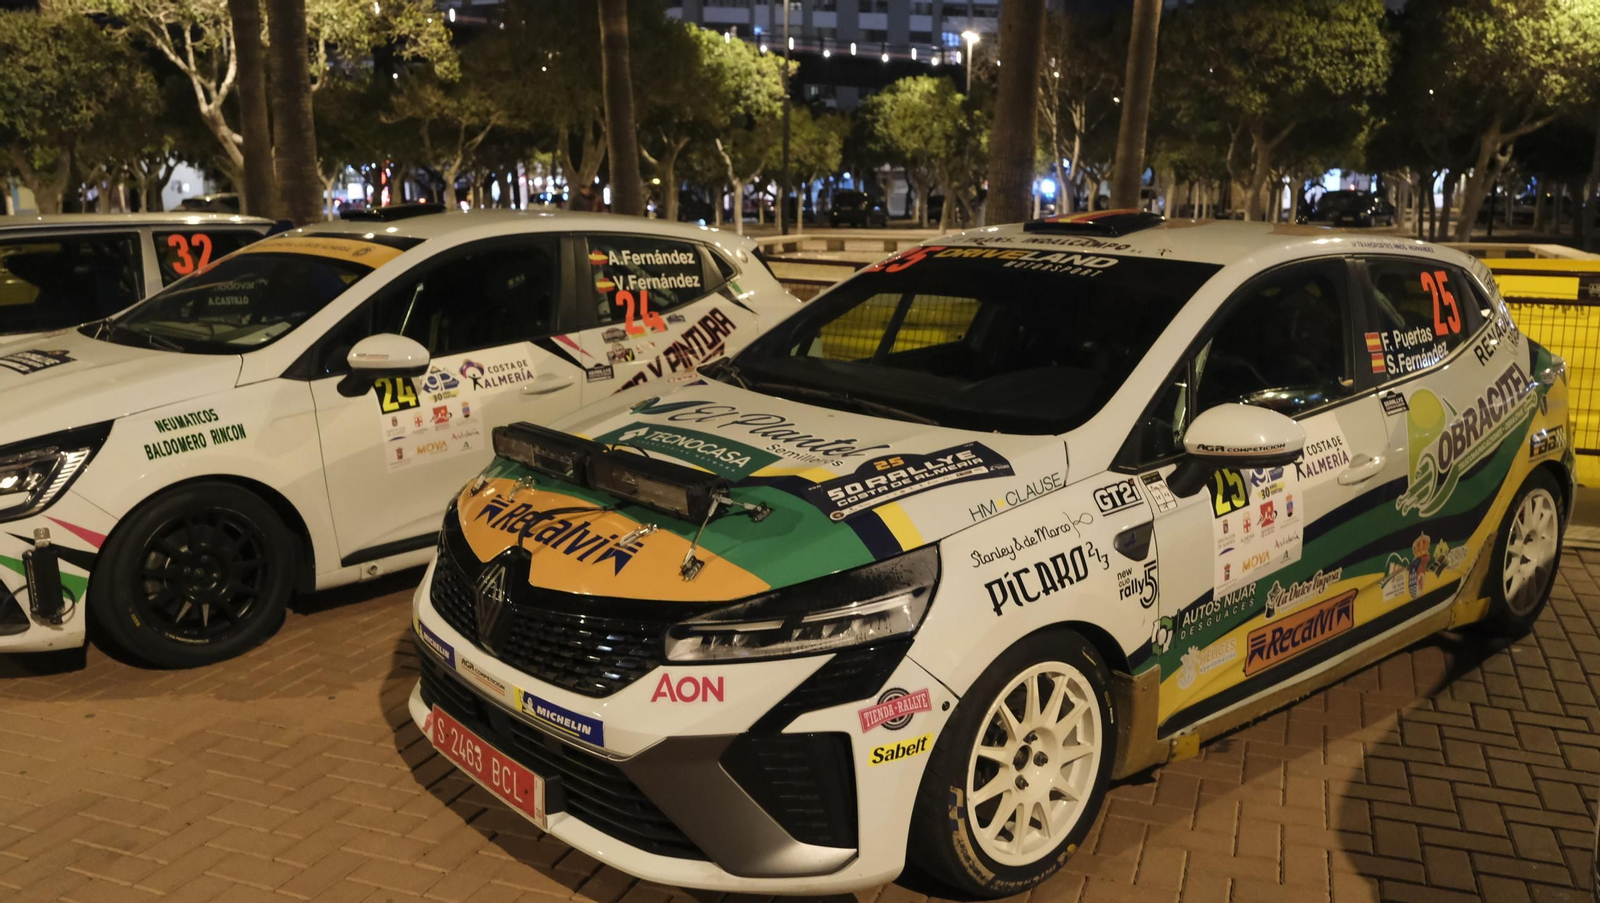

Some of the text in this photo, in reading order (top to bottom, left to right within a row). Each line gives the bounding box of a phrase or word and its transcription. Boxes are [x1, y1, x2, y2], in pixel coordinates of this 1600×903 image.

[168, 233, 213, 277] 32
[608, 249, 695, 266] A.Fernández
[932, 247, 1119, 269] DRIVELAND
[1003, 260, 1103, 277] MOTORSPORT
[613, 273, 701, 291] V.Fernández
[615, 290, 668, 335] 24
[1420, 270, 1461, 336] 25
[662, 307, 737, 373] PINTURA
[1393, 326, 1433, 349] Puertas
[487, 359, 528, 374] COSTA DE
[1386, 341, 1449, 374] S.Fernández
[484, 369, 534, 389] ALMERÍA
[374, 377, 416, 412] 24
[154, 408, 219, 433] NEUMATICOS
[1438, 361, 1535, 471] OBRACITEL
[144, 423, 247, 460] BALDOMERO RINCON
[416, 440, 448, 455] MOYA
[643, 430, 751, 468] TECNOCASA
[716, 413, 890, 458] Plantel
[1196, 443, 1286, 453] AGR COMPETICION
[1306, 435, 1343, 456] COSTA DE
[766, 443, 844, 467] Semilleros
[873, 456, 905, 471] 25
[1305, 448, 1350, 478] ALMERÍA
[827, 480, 864, 502] 50
[865, 449, 978, 489] RALLYE
[836, 484, 890, 508] COSTA
[891, 478, 912, 489] DE
[969, 499, 997, 521] HM
[1005, 472, 1064, 507] CLAUSE
[1093, 478, 1142, 513] GT2i
[1215, 468, 1246, 516] 25
[1260, 486, 1271, 500] 30
[970, 525, 1071, 568] Stanley & de Marco
[1117, 567, 1133, 580] new
[1242, 551, 1270, 573] MOYA
[1180, 598, 1255, 640] DESGUACES
[1182, 599, 1221, 627] AUTOS
[1223, 583, 1257, 608] NIJAR
[424, 632, 450, 659] MICHELIN
[461, 658, 505, 691] AGR COMPETICION
[650, 673, 724, 703] AON
[536, 705, 592, 735] MICHELIN
[863, 693, 928, 727] TIENDA RALLYE
[437, 717, 445, 744] S
[451, 728, 483, 772] 2463
[492, 757, 523, 803] BCL
[872, 736, 928, 764] Sabelt
